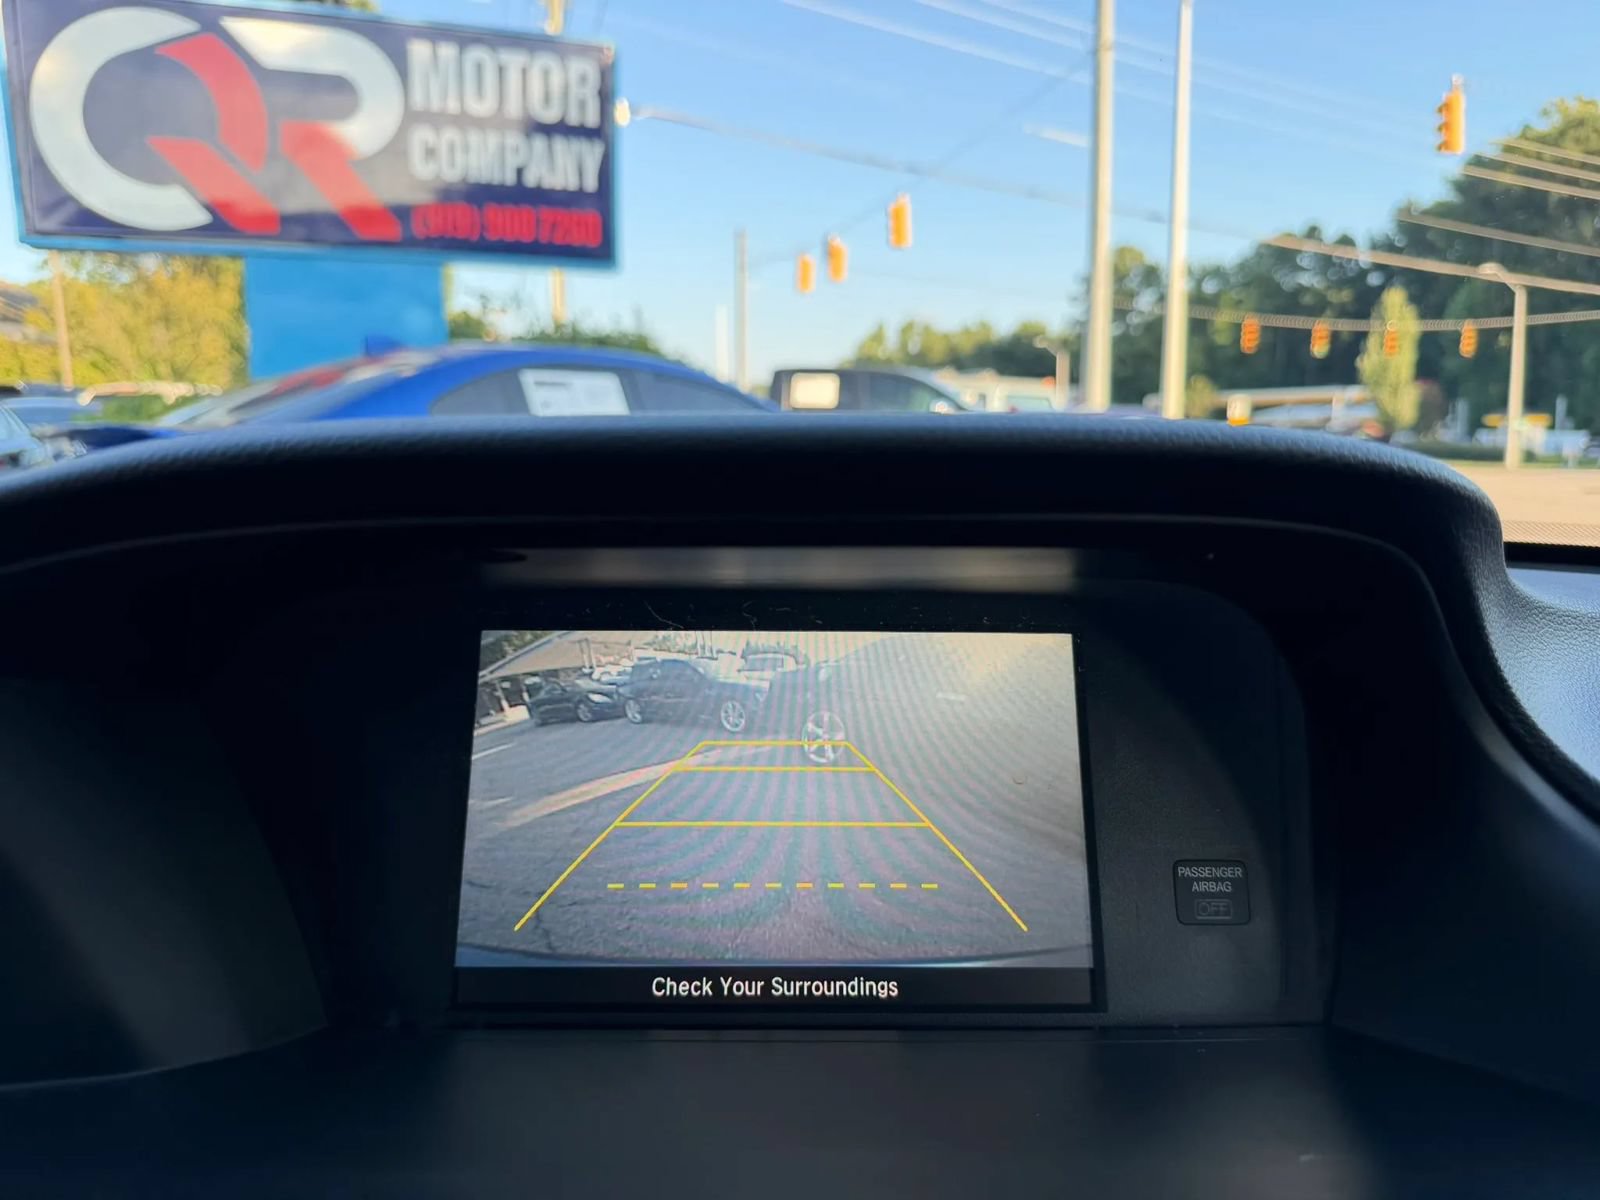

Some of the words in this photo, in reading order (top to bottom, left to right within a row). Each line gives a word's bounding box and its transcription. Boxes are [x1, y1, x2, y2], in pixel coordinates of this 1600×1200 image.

[406, 38, 601, 129] MOTOR
[407, 123, 605, 193] COMPANY
[1177, 866, 1243, 878] PASSENGER
[1191, 881, 1232, 893] AIRBAG
[651, 976, 713, 997] Check
[720, 976, 765, 997] Your
[771, 976, 899, 999] Surroundings
